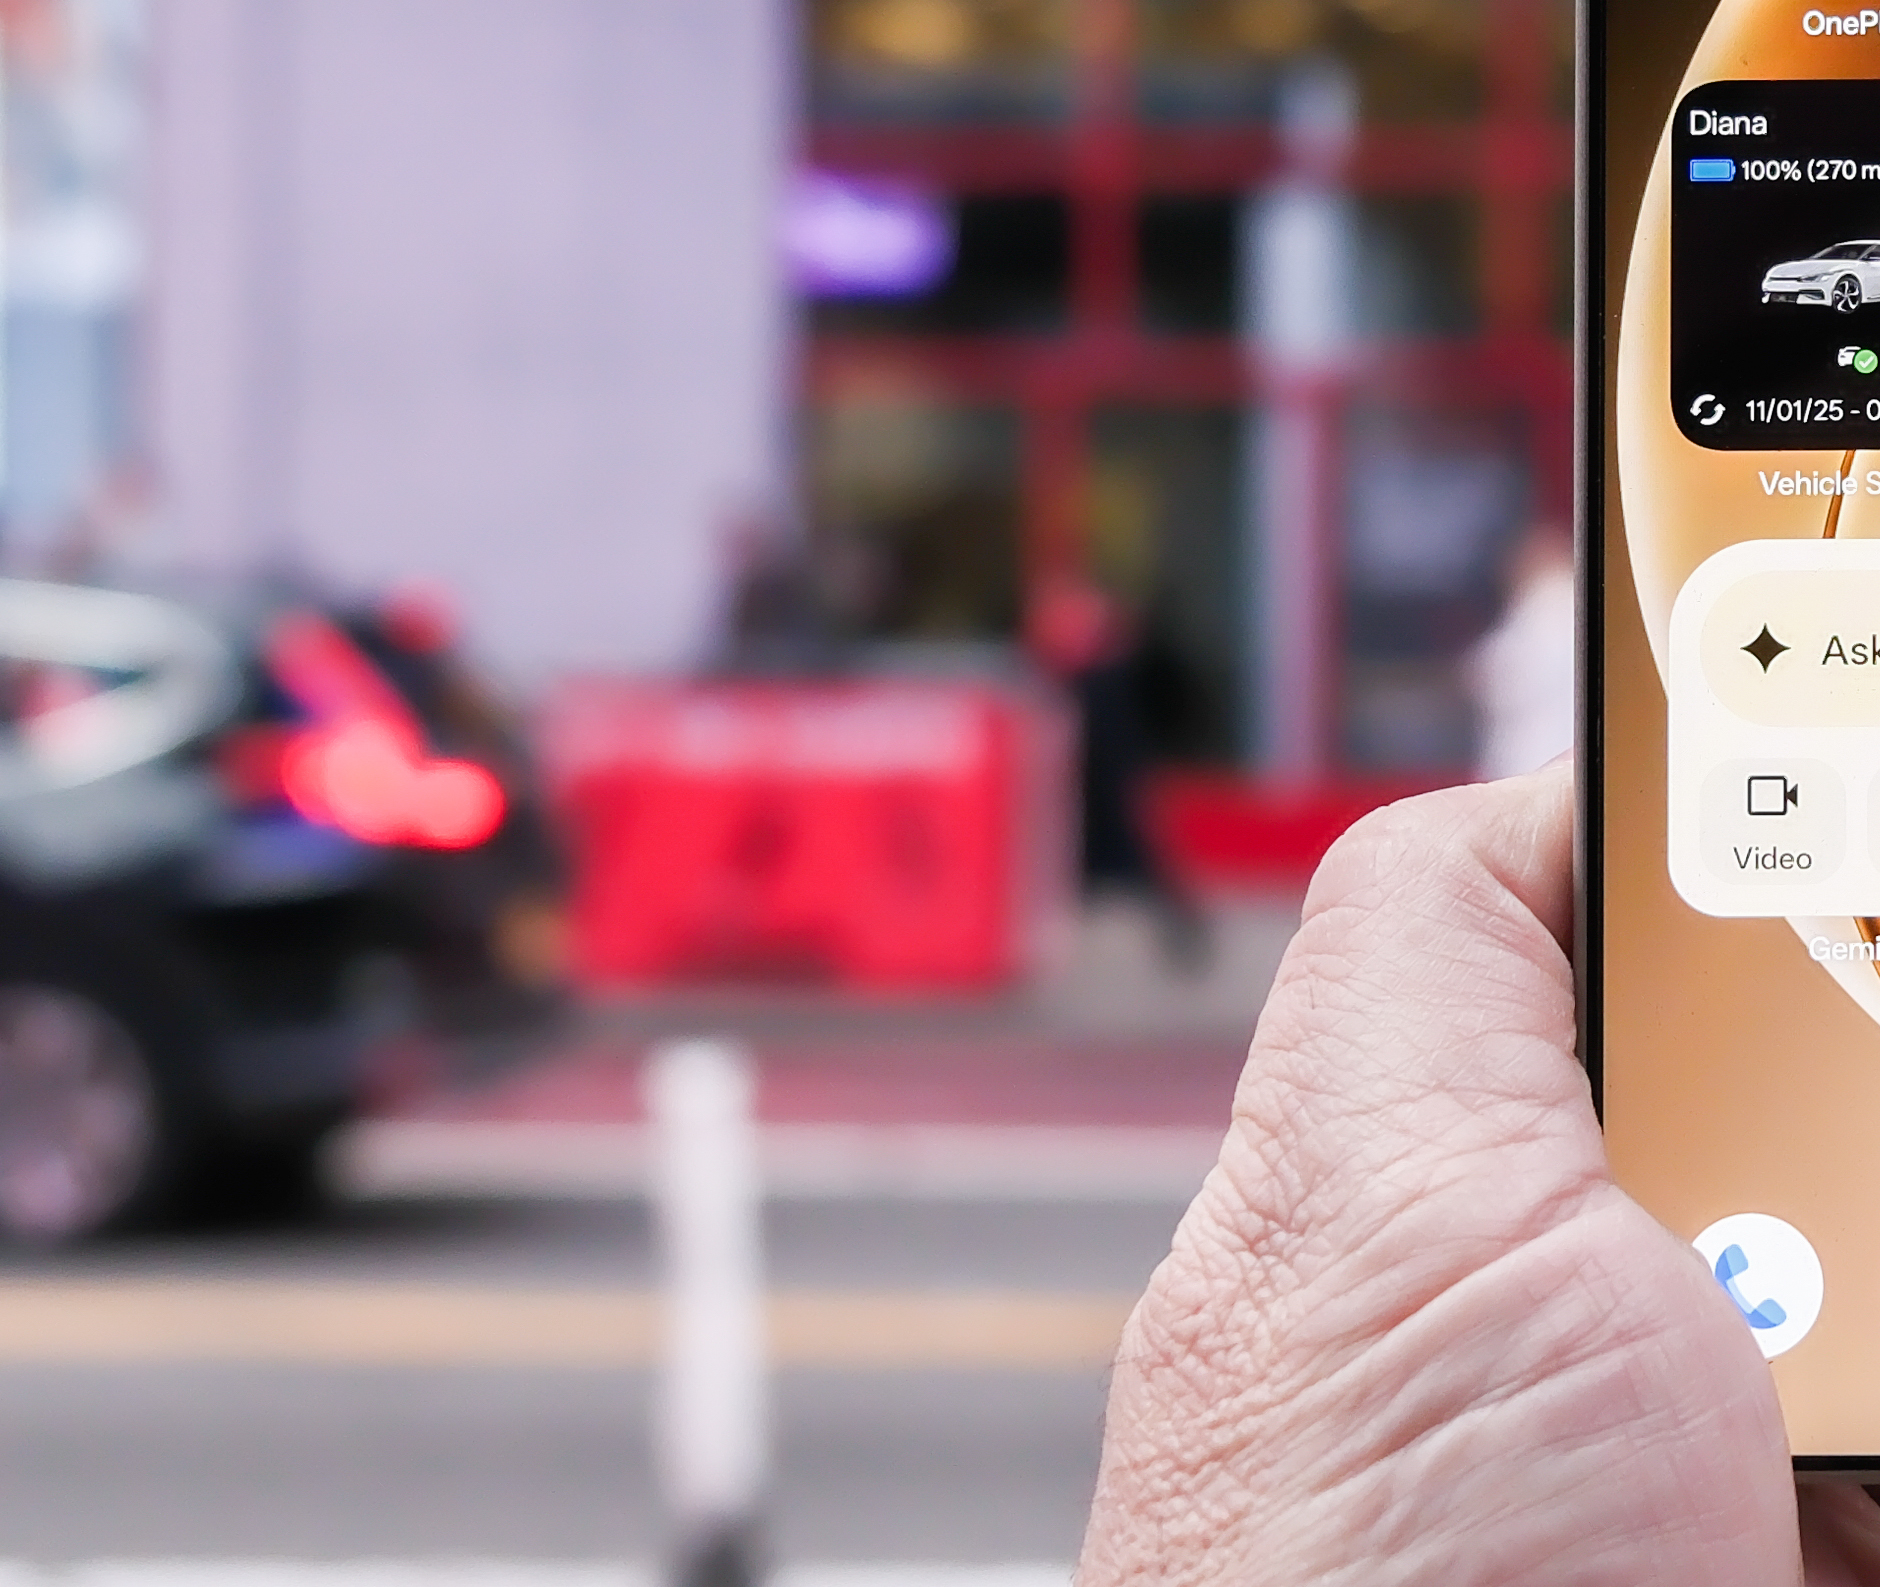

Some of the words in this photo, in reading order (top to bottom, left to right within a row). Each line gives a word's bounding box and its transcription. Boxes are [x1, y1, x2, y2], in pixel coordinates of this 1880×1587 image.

[1690, 110, 1768, 136] Diana
[1741, 159, 1802, 182] 100%
[1807, 158, 1857, 183] (270
[1745, 398, 1844, 424] 11/01/25
[1758, 470, 1858, 496] Vehicle
[1733, 846, 1812, 870] Video
